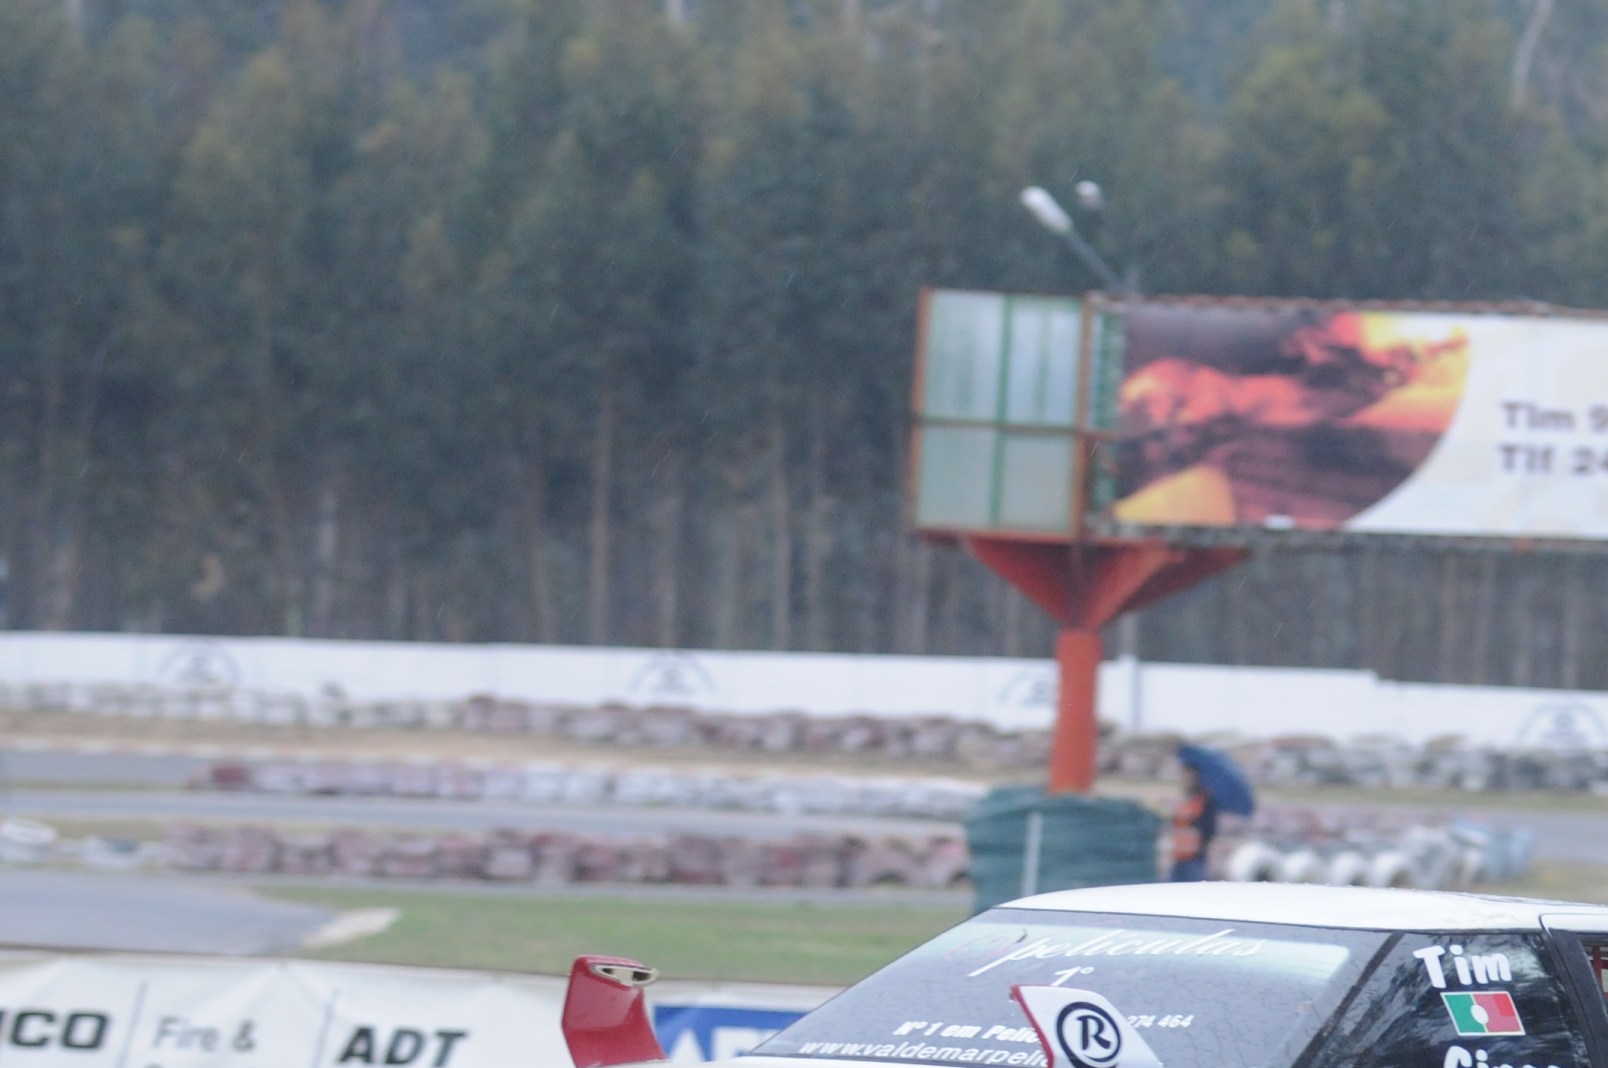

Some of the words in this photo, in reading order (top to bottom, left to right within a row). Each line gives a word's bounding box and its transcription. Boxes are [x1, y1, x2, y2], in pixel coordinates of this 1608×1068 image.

[1498, 444, 1555, 473] Tlf
[1412, 944, 1513, 989] Tim
[0, 1009, 110, 1051] CO
[152, 1016, 218, 1053] Fire
[230, 1018, 258, 1054] &
[940, 1024, 980, 1039] em
